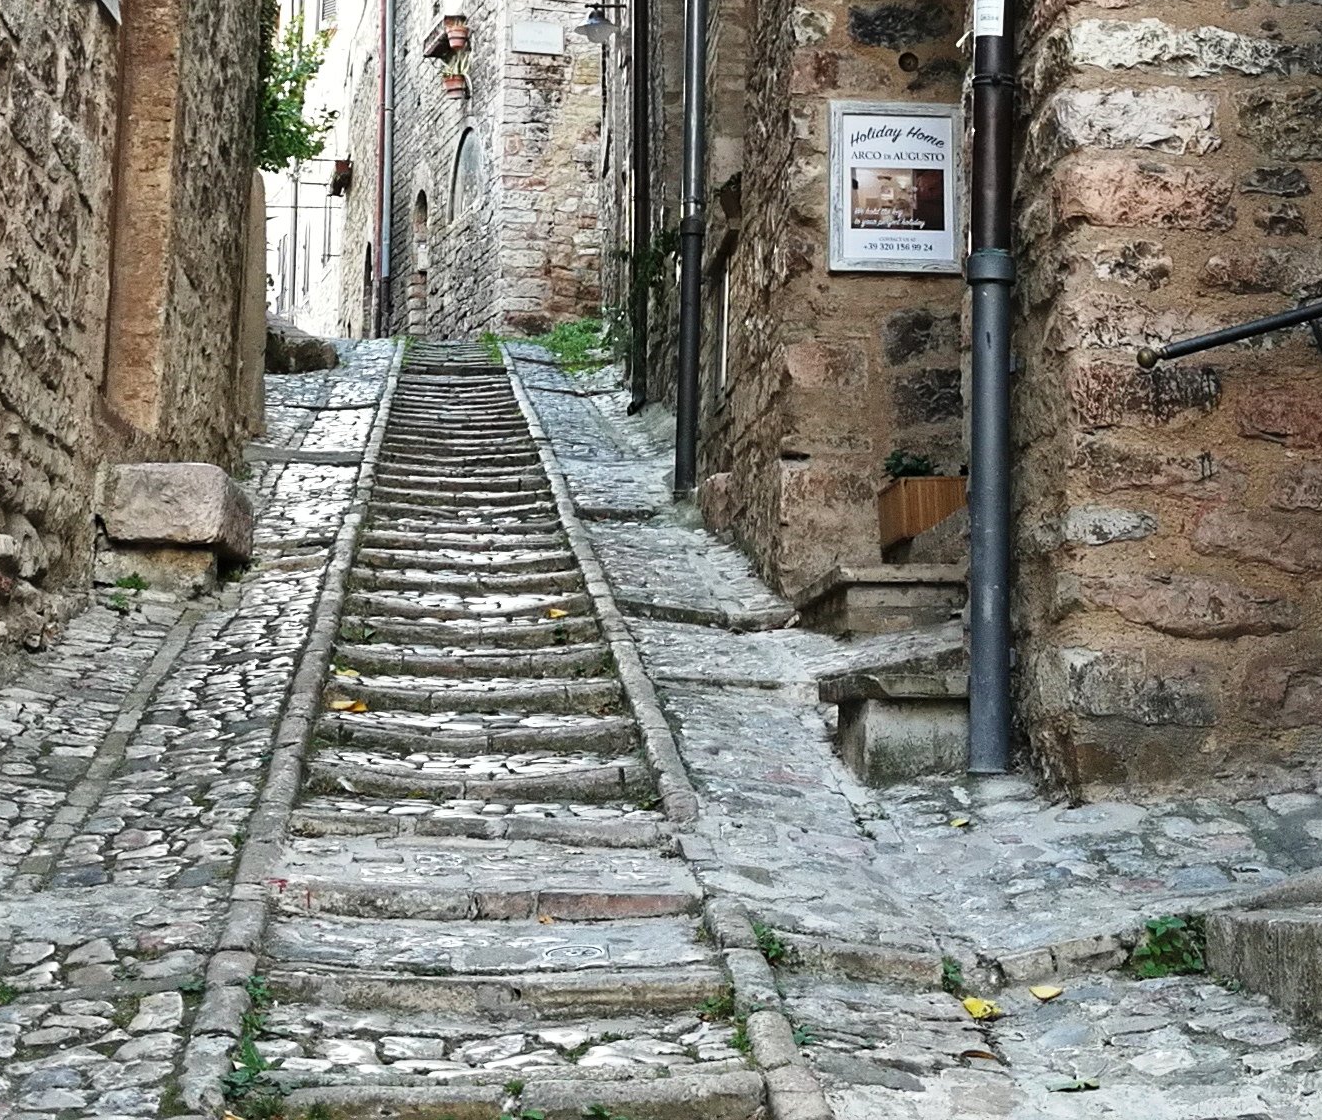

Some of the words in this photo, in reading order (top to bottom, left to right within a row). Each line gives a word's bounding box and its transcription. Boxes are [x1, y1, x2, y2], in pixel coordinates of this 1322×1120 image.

[850, 124, 902, 148] Holiday
[906, 126, 945, 149] Home
[851, 151, 882, 160] ARCO
[893, 152, 945, 162] AUGUSTO
[863, 242, 878, 250] +39
[880, 243, 894, 251] 320
[923, 243, 933, 252] 24
